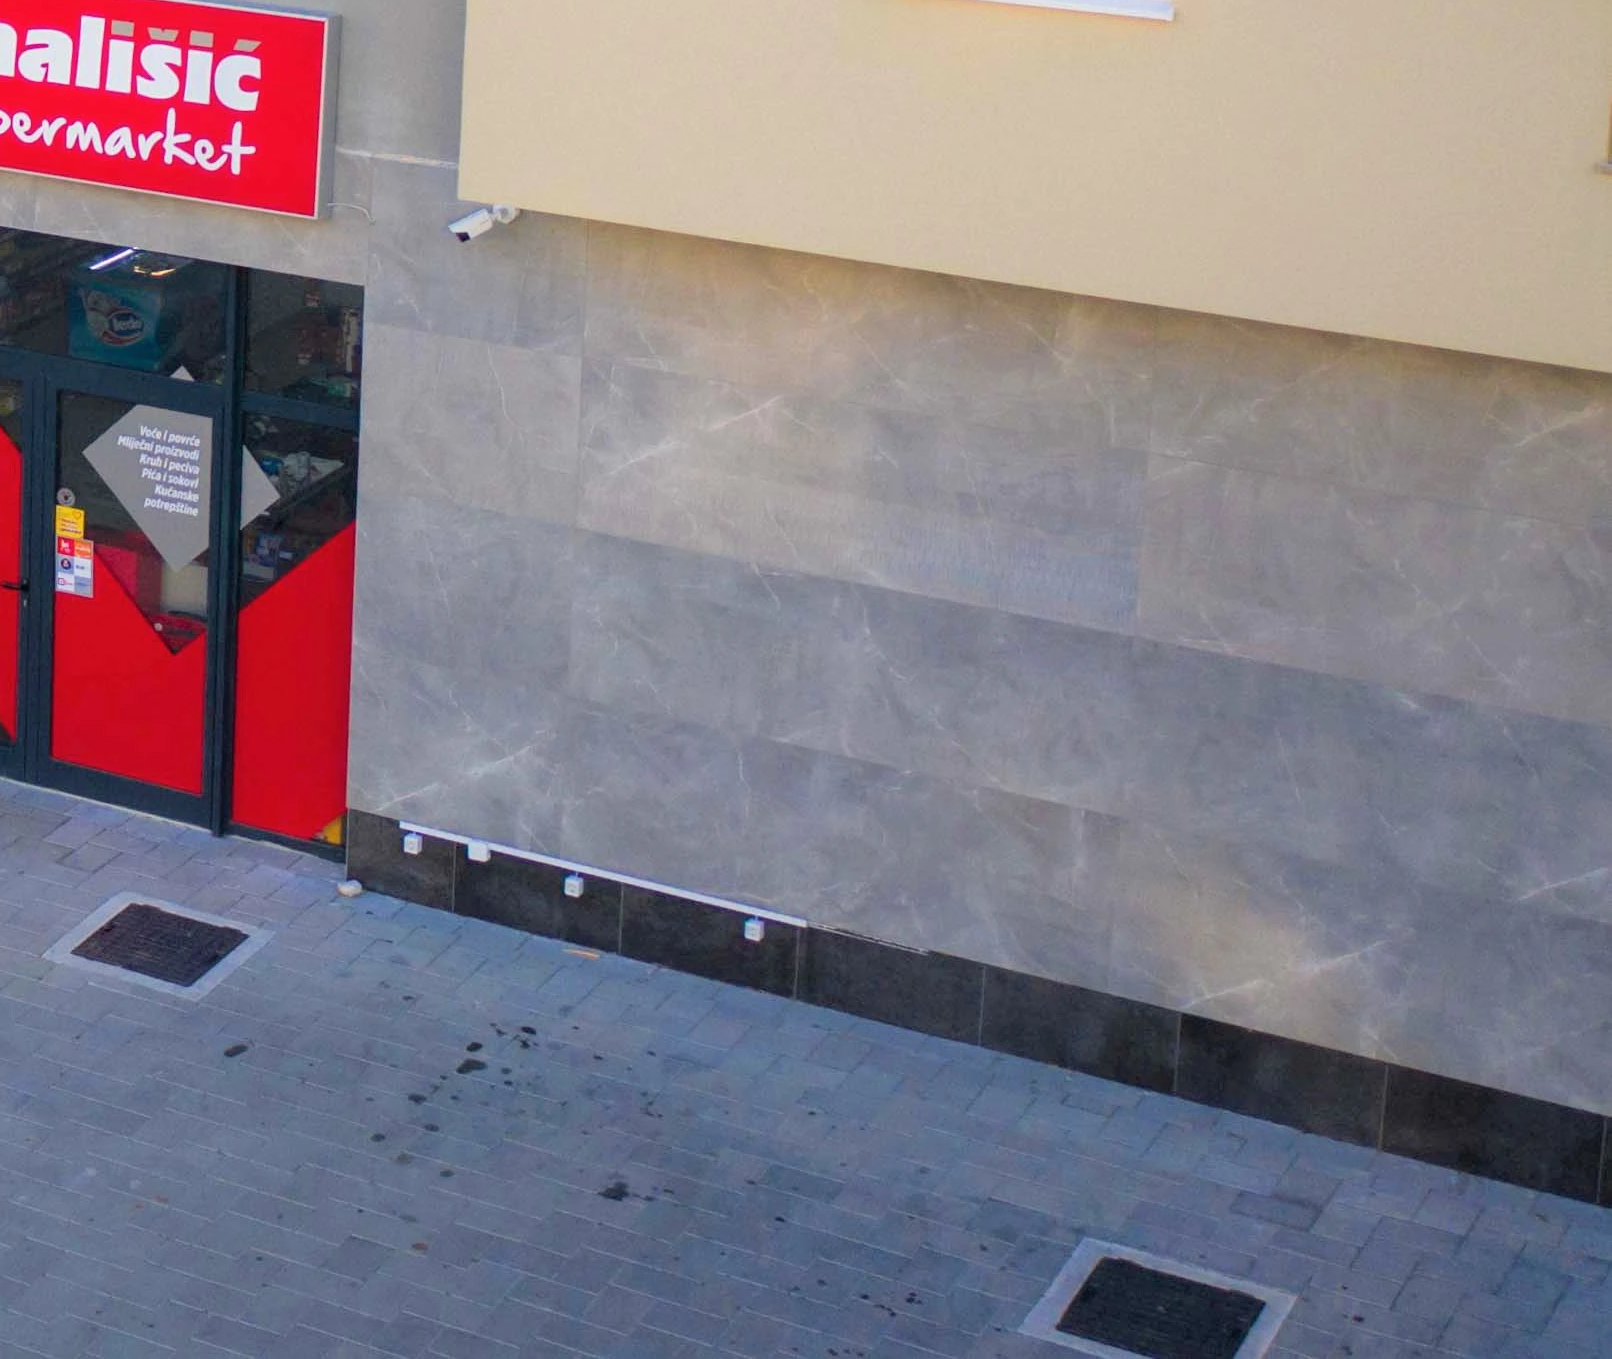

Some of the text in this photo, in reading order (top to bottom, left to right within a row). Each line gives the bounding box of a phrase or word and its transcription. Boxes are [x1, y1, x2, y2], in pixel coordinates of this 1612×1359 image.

[140, 425, 162, 440] Voće
[168, 431, 201, 447] povrće
[117, 435, 201, 460] Mliječni proizvodi
[139, 453, 162, 467] Kruh
[168, 459, 200, 475] peciva
[141, 468, 162, 481] Pića
[167, 474, 200, 488] sokovi
[154, 484, 199, 502] Kućanske
[143, 497, 199, 517] potrepštine
